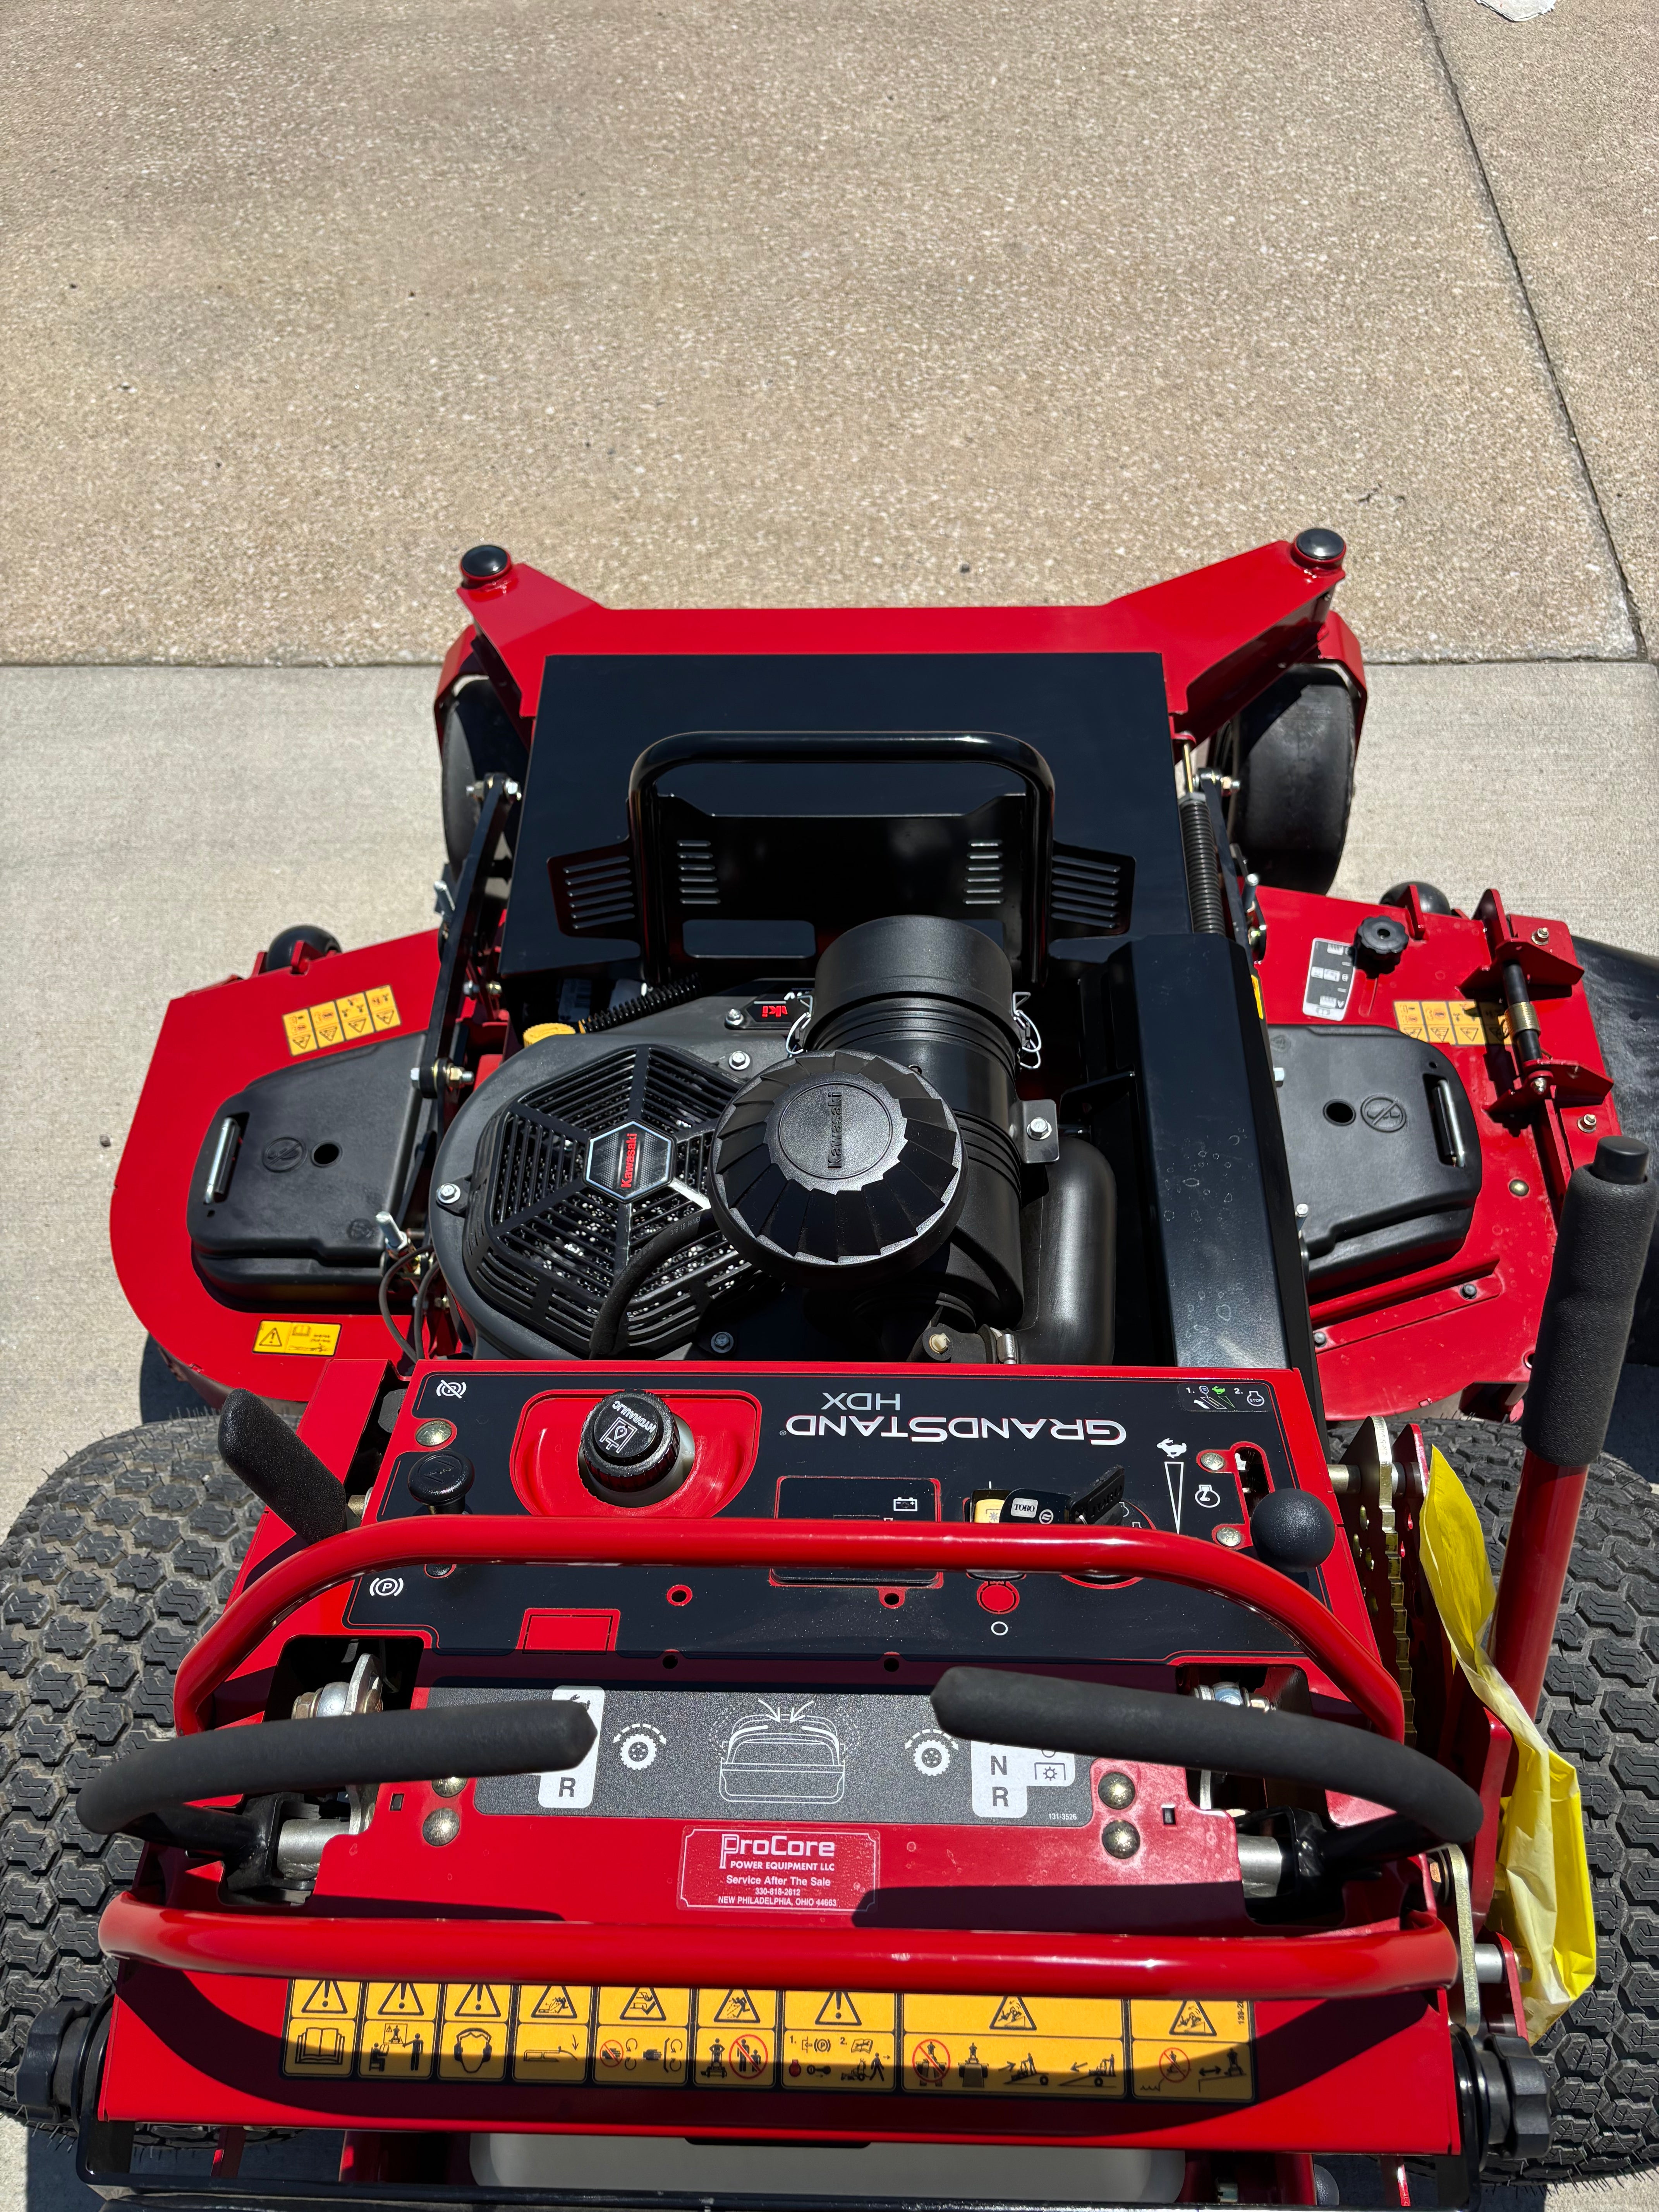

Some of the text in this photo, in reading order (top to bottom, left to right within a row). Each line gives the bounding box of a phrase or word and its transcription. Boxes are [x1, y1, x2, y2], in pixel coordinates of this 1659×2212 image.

[828, 1091, 842, 1169] Kawasaki
[621, 1133, 637, 1188] Kawasaki
[821, 1393, 900, 1411] HDX
[612, 1400, 657, 1433] HYDRAULIC
[1014, 1503, 1035, 1513] TORO
[991, 1755, 1007, 1775] N
[558, 1777, 576, 1797] R
[992, 1786, 1009, 1807] R
[719, 1833, 835, 1869] ProCore
[730, 1860, 835, 1871] POWER EQUIPMENT LLC
[726, 1874, 831, 1886] Service After The Sale
[755, 1887, 800, 1896] 330-818-2612
[718, 1896, 837, 1906] NEW PHILADELPHIA, OHIO 44663
[790, 2035, 797, 2044] 1.
[840, 2037, 848, 2045] 2.
